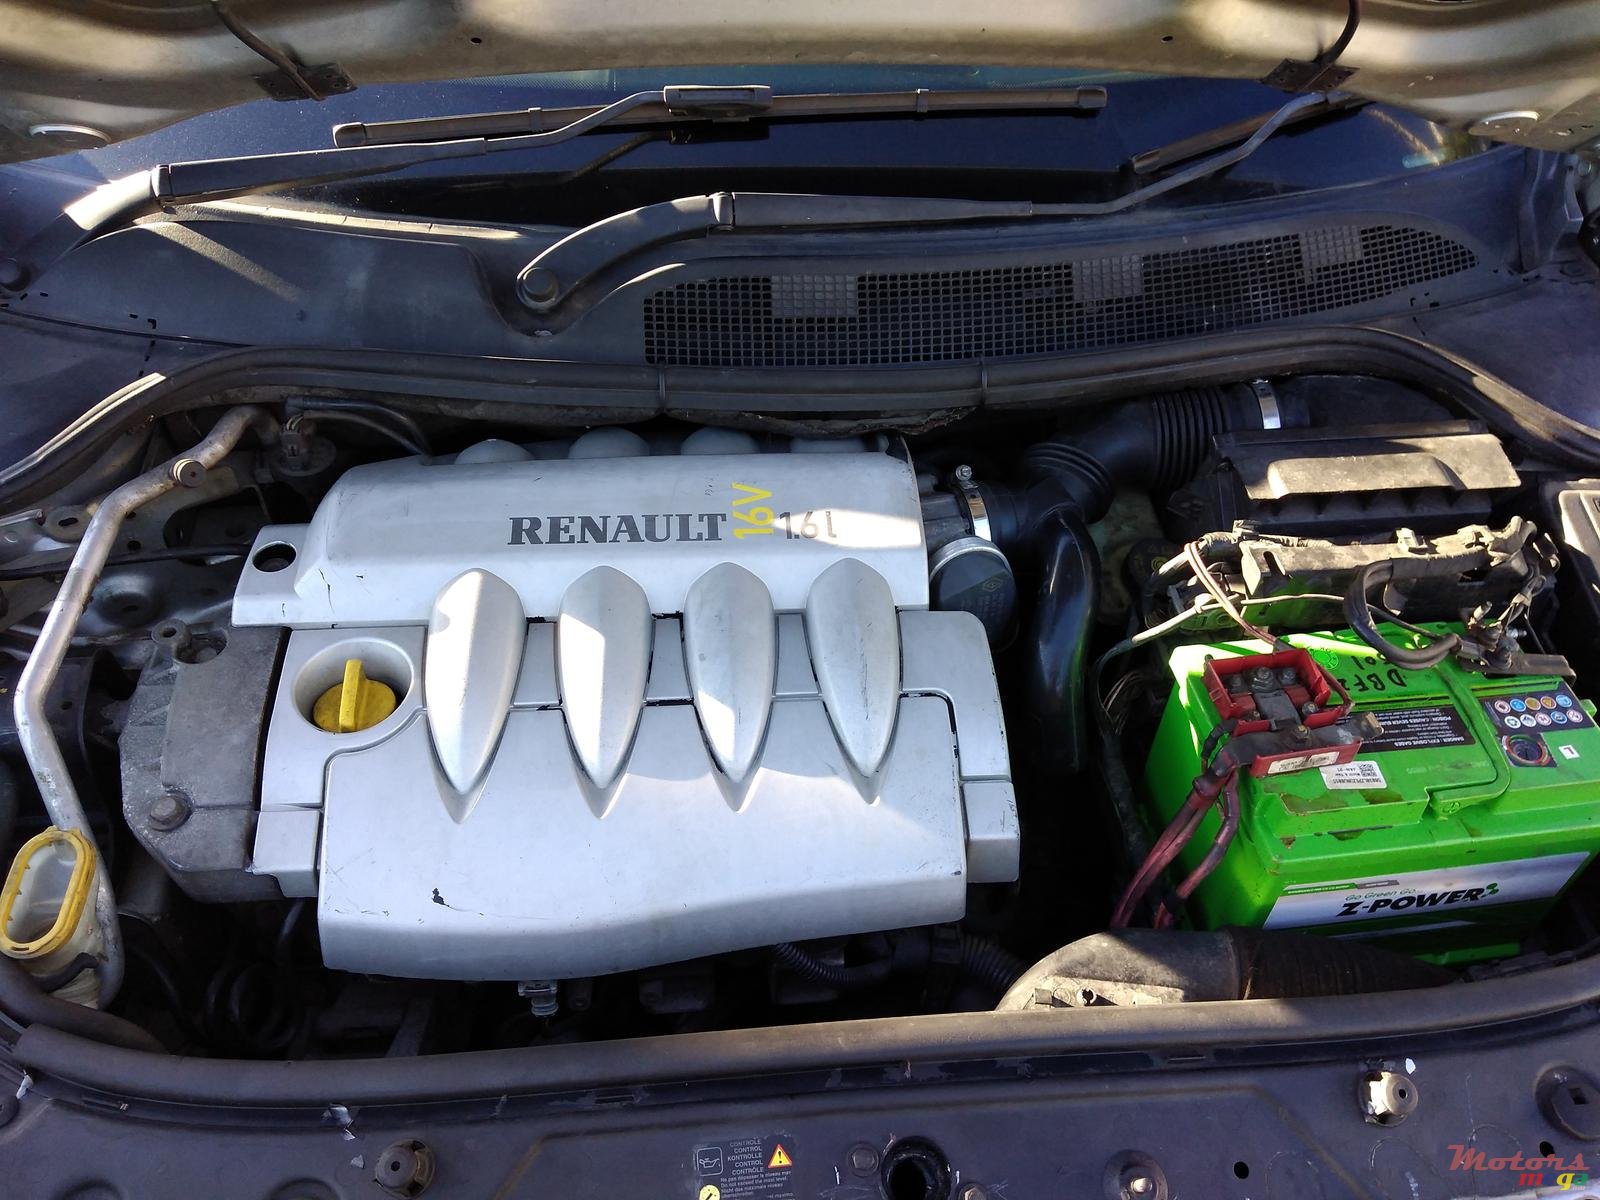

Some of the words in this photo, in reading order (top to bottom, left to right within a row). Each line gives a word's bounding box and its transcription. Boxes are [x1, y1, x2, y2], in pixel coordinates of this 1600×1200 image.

[731, 482, 774, 539] 16V
[507, 513, 727, 545] RENAULT
[1336, 885, 1486, 917] Z-POWER
